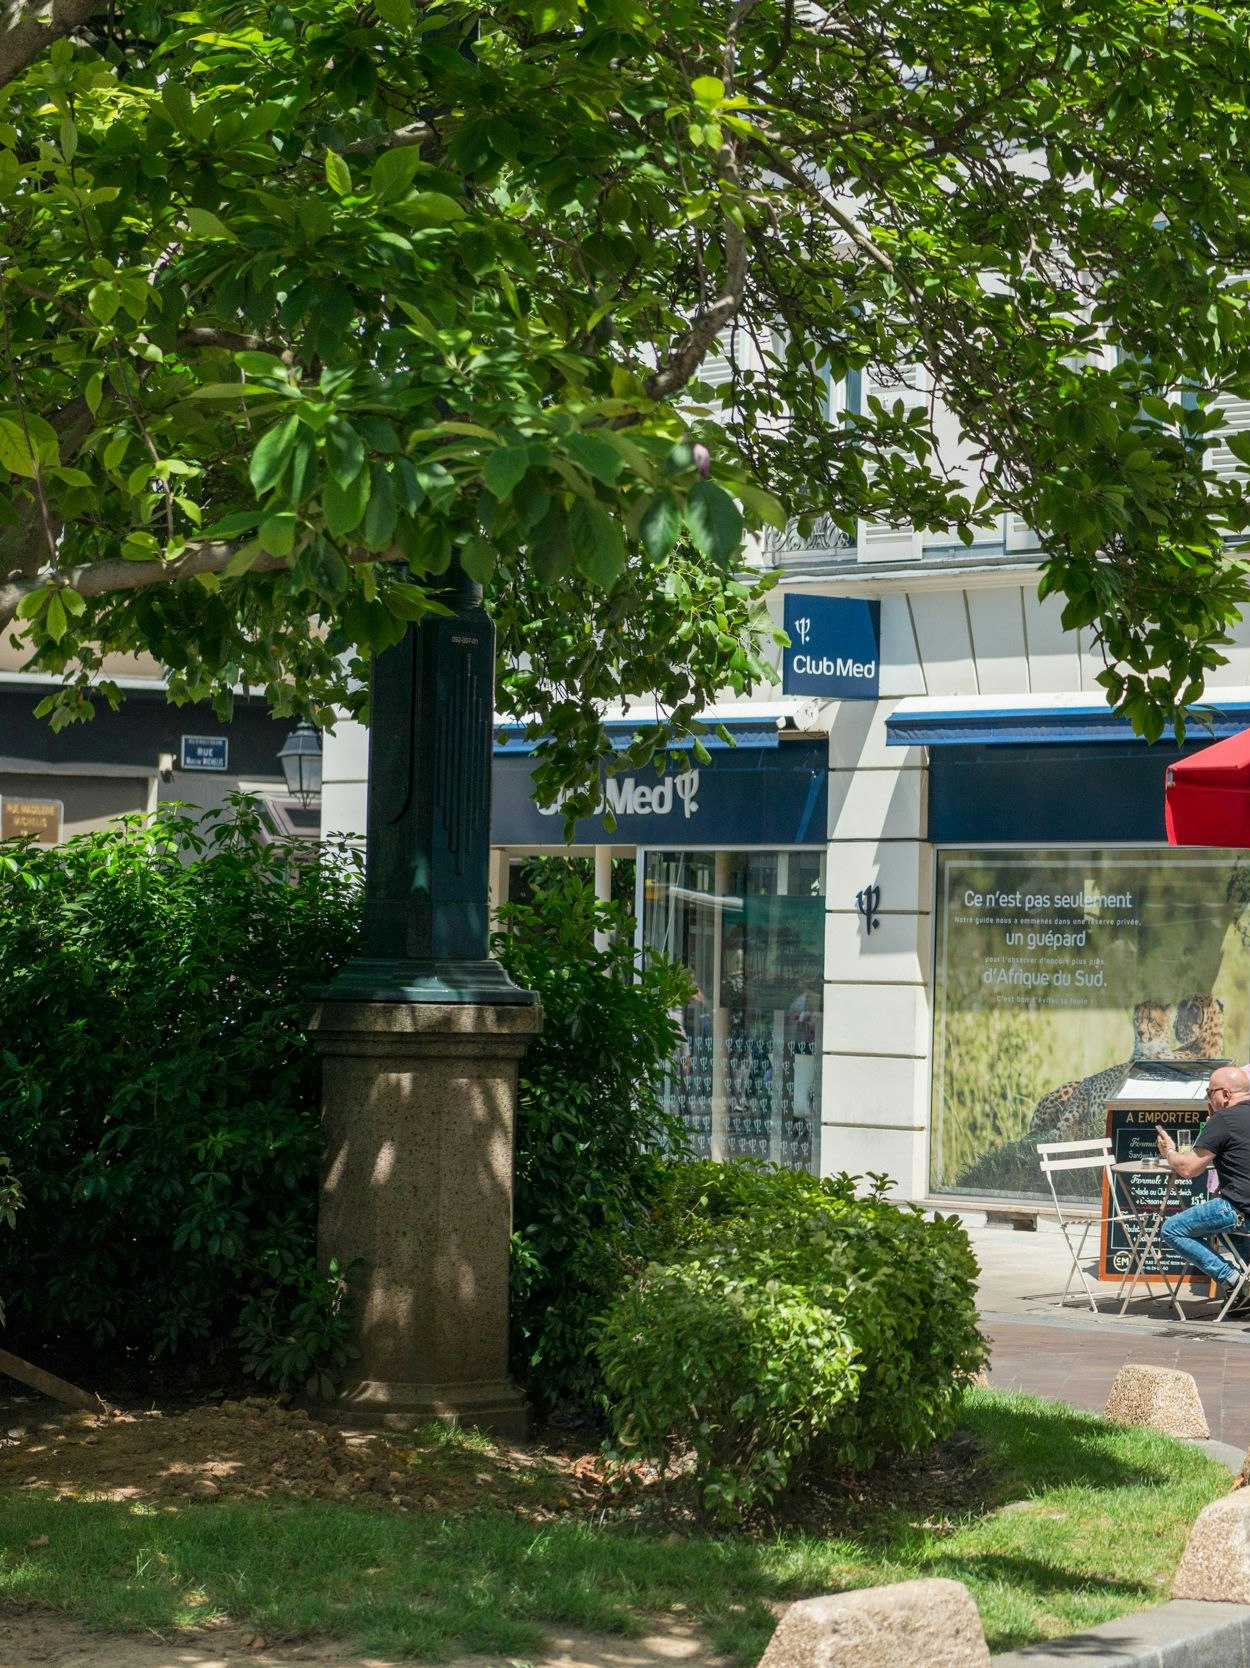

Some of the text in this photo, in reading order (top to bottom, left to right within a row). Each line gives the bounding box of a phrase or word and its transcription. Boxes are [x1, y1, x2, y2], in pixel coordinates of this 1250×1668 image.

[793, 654, 876, 679] Club Med
[605, 776, 674, 815] Med
[964, 890, 1133, 912] Ce n'est pas seulement
[975, 916, 994, 926] guide
[1054, 918, 1071, 926] dans
[1006, 930, 1086, 950] un guépard
[983, 967, 1108, 989] d'Afrique du Sud.
[1126, 1111, 1200, 1123] A EMPORTER
[1130, 1174, 1161, 1185] Formule
